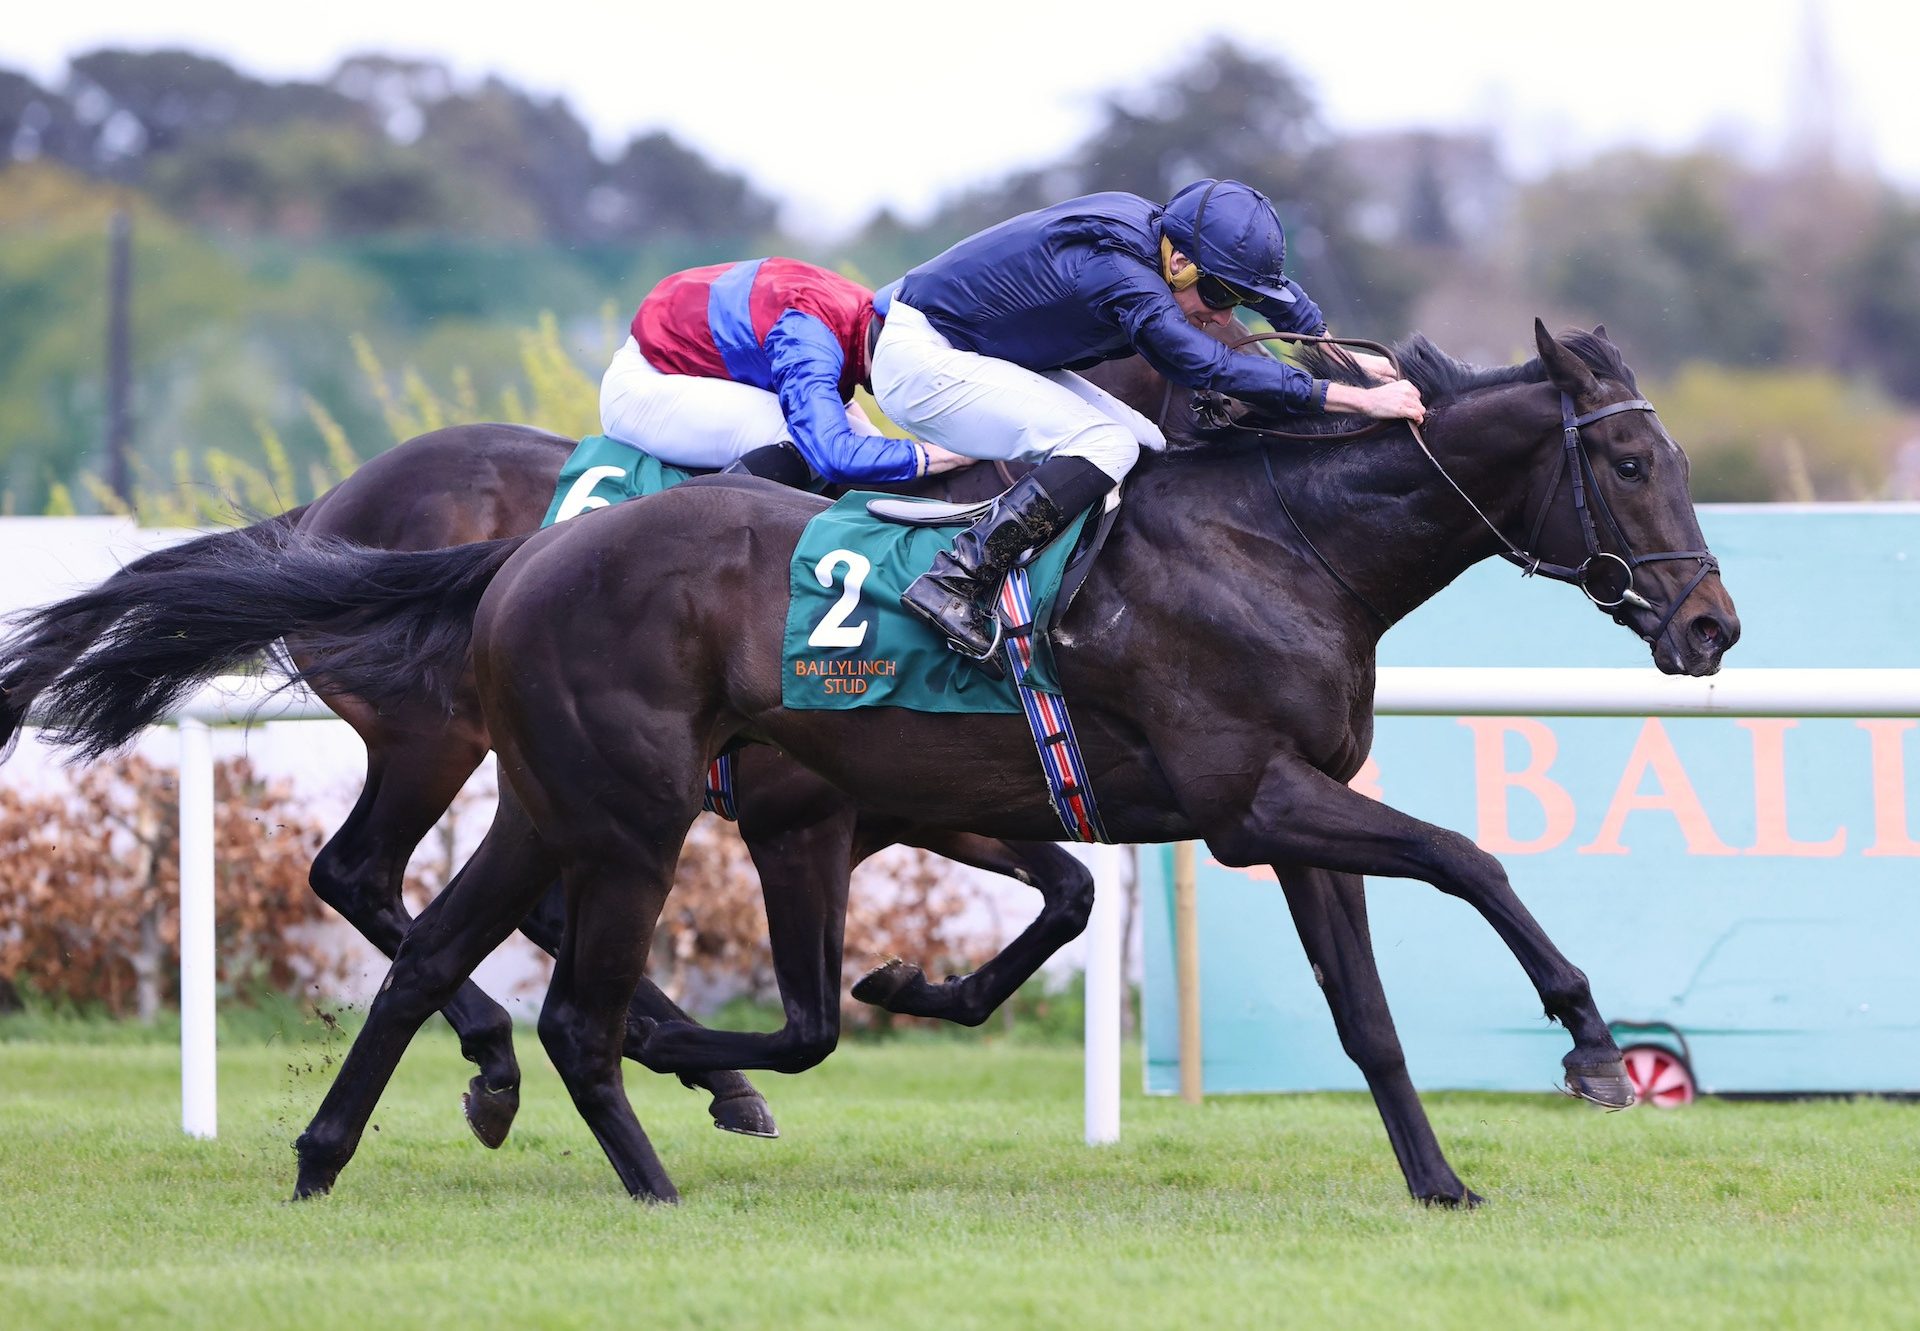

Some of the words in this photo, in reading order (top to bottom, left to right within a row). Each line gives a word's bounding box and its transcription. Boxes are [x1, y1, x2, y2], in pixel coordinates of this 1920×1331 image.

[808, 549, 871, 647] 2
[795, 659, 897, 676] BALLYLINCH
[824, 678, 868, 695] STUD
